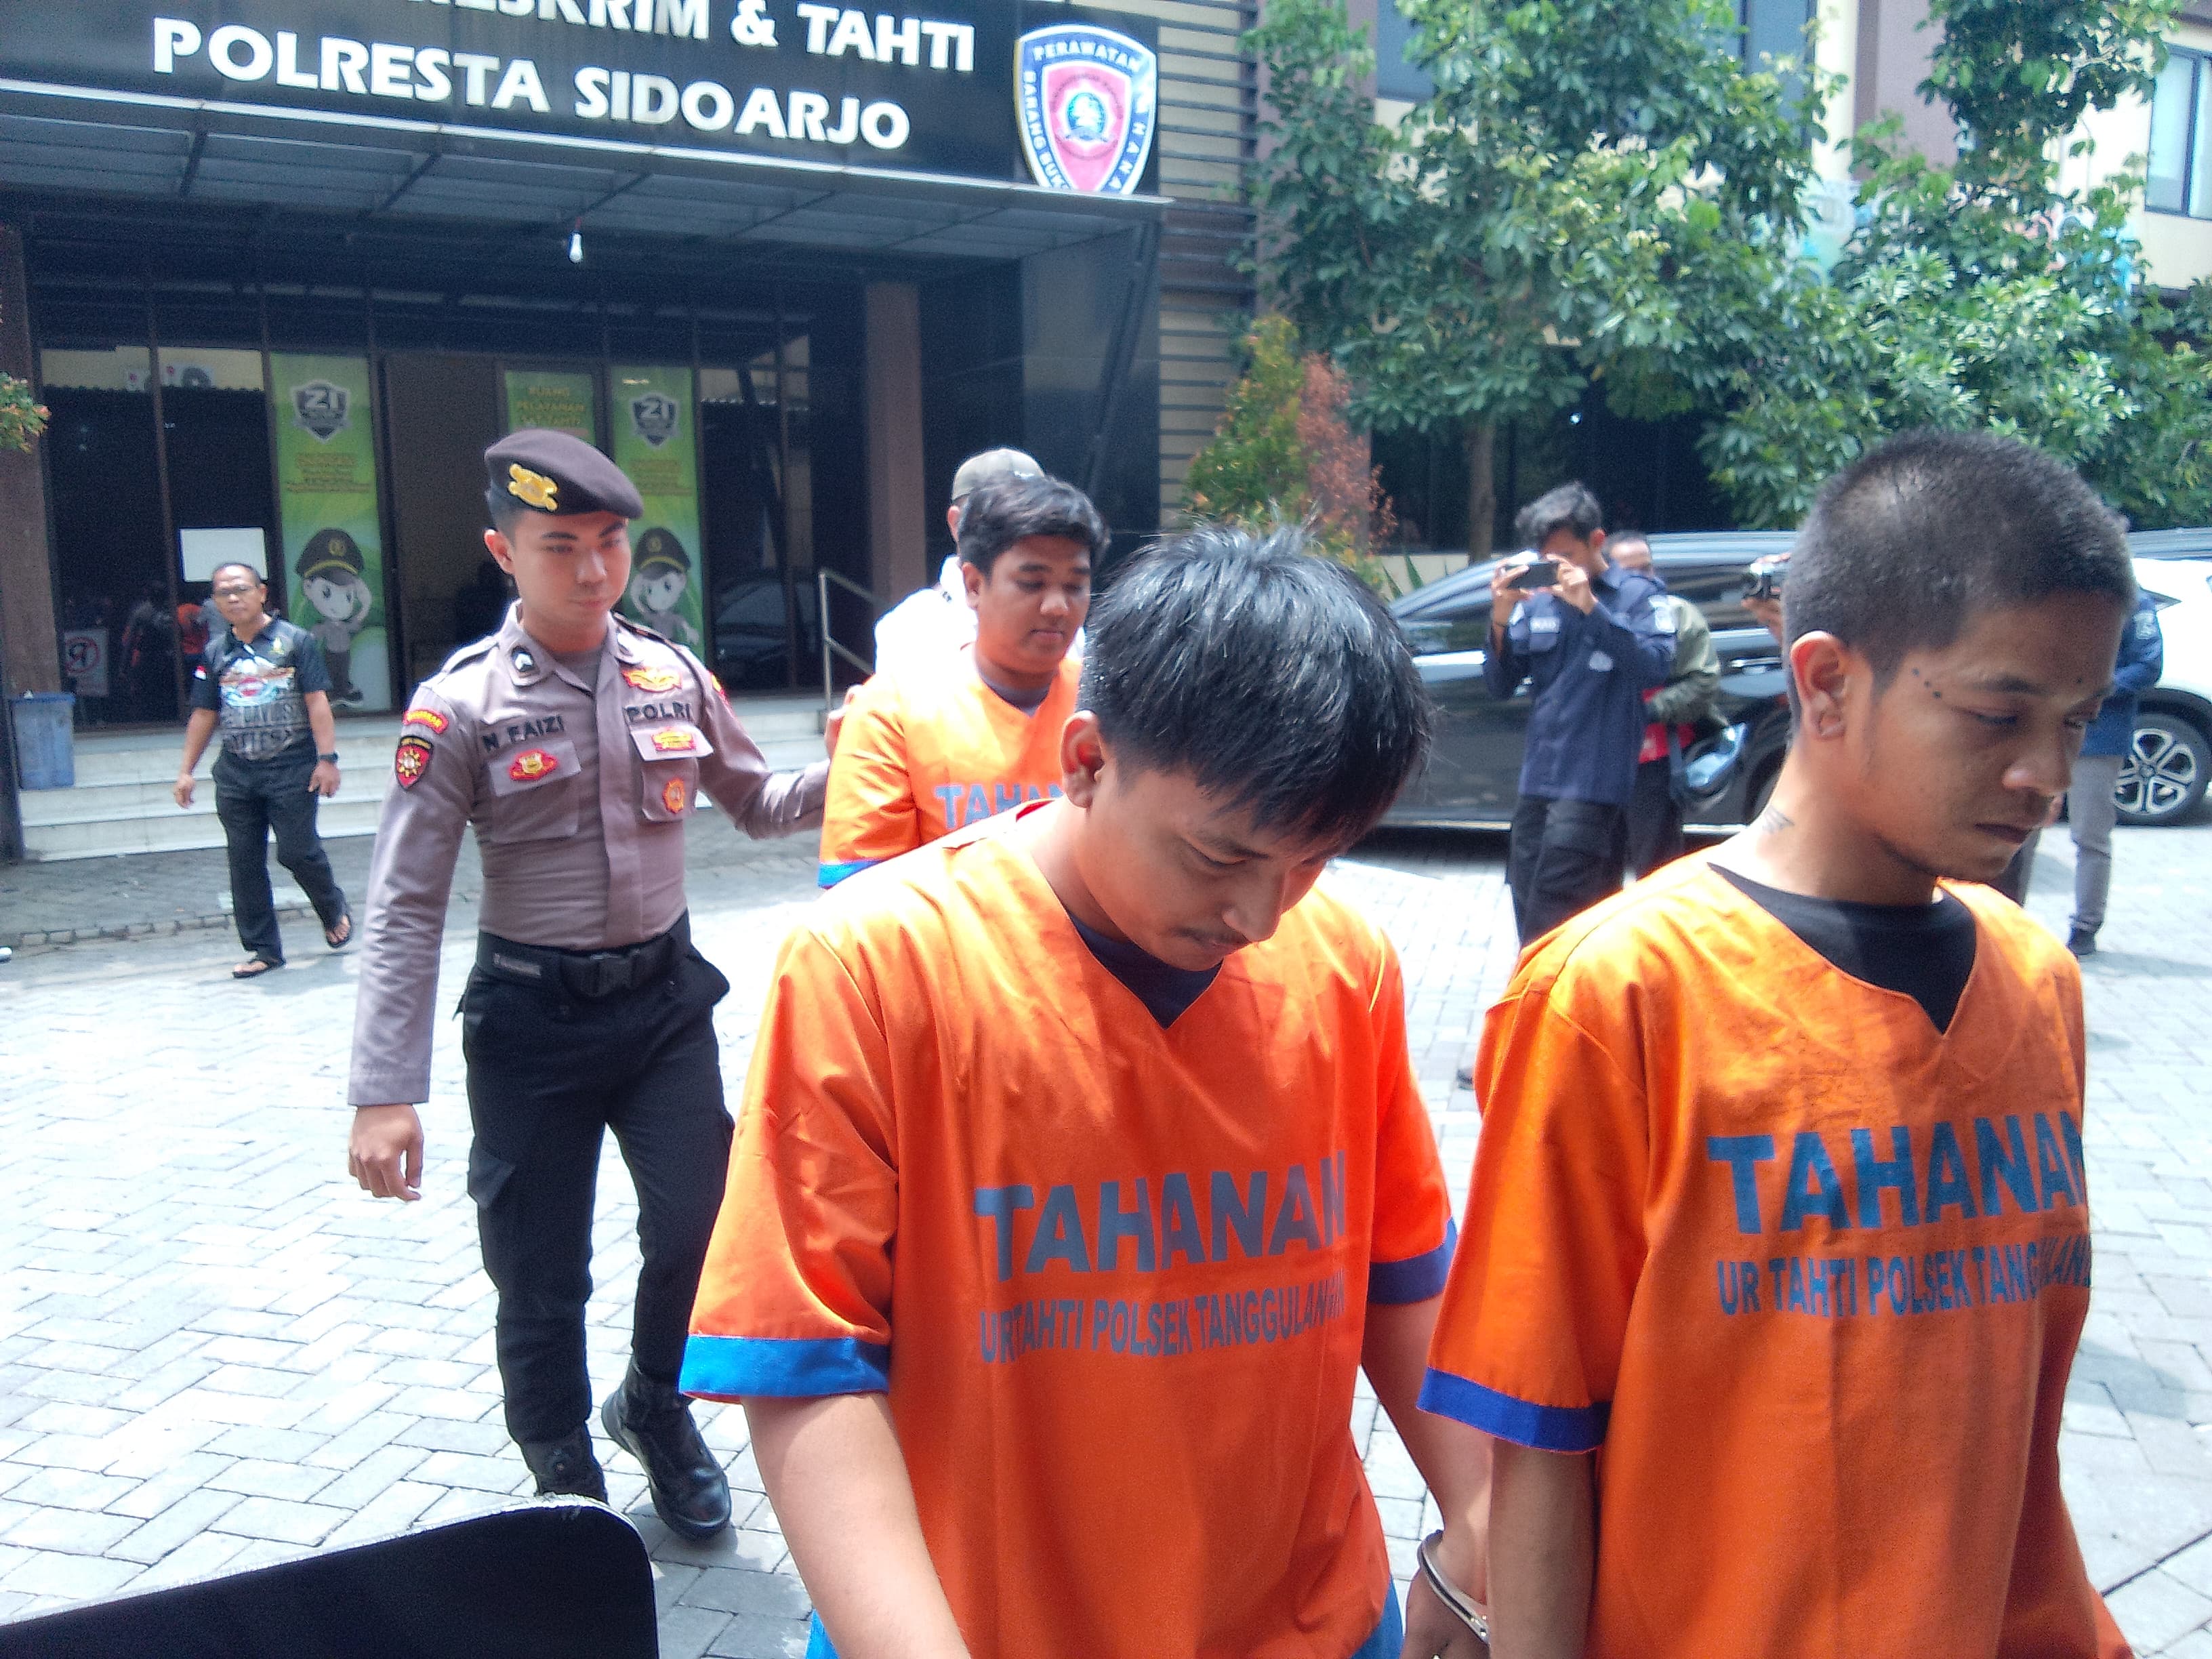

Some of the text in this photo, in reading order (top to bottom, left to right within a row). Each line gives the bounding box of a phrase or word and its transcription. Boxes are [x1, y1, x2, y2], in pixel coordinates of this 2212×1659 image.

[730, 0, 779, 47] &
[796, 3, 976, 72] TAHTI
[152, 17, 911, 150] POLRESTA SIDOARJO
[626, 700, 691, 723] POLRI
[974, 1149, 1346, 1282] TAHANAN
[1717, 1261, 1760, 1315] UR
[1769, 1256, 1858, 1318] TAHTI
[1868, 1250, 1973, 1315] POLSEK
[1092, 1298, 1193, 1357] POLSEK
